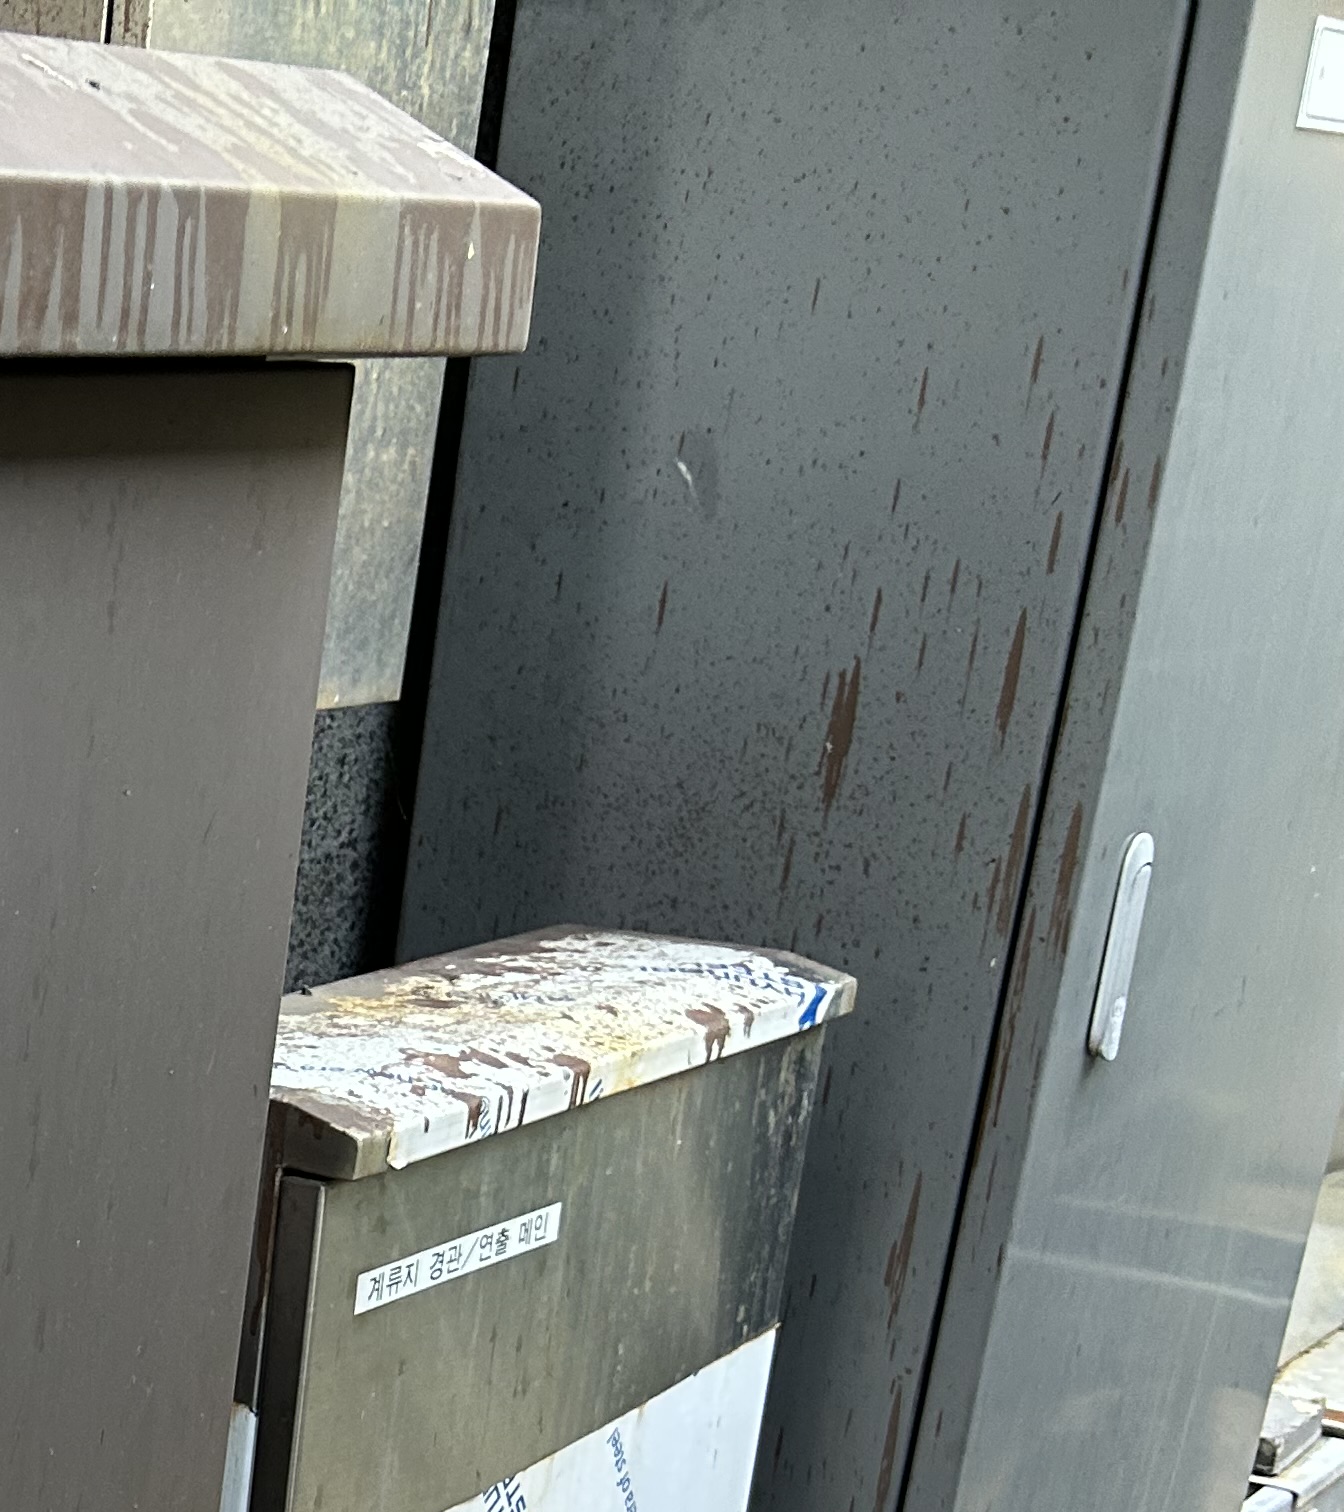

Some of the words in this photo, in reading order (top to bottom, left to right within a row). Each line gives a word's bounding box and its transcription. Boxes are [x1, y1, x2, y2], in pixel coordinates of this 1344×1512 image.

[367, 1259, 421, 1302] 계류지
[429, 1227, 512, 1281] 경관/연출
[518, 1211, 550, 1246] 메인
[607, 1427, 627, 1472] steel
[616, 1471, 631, 1493] of
